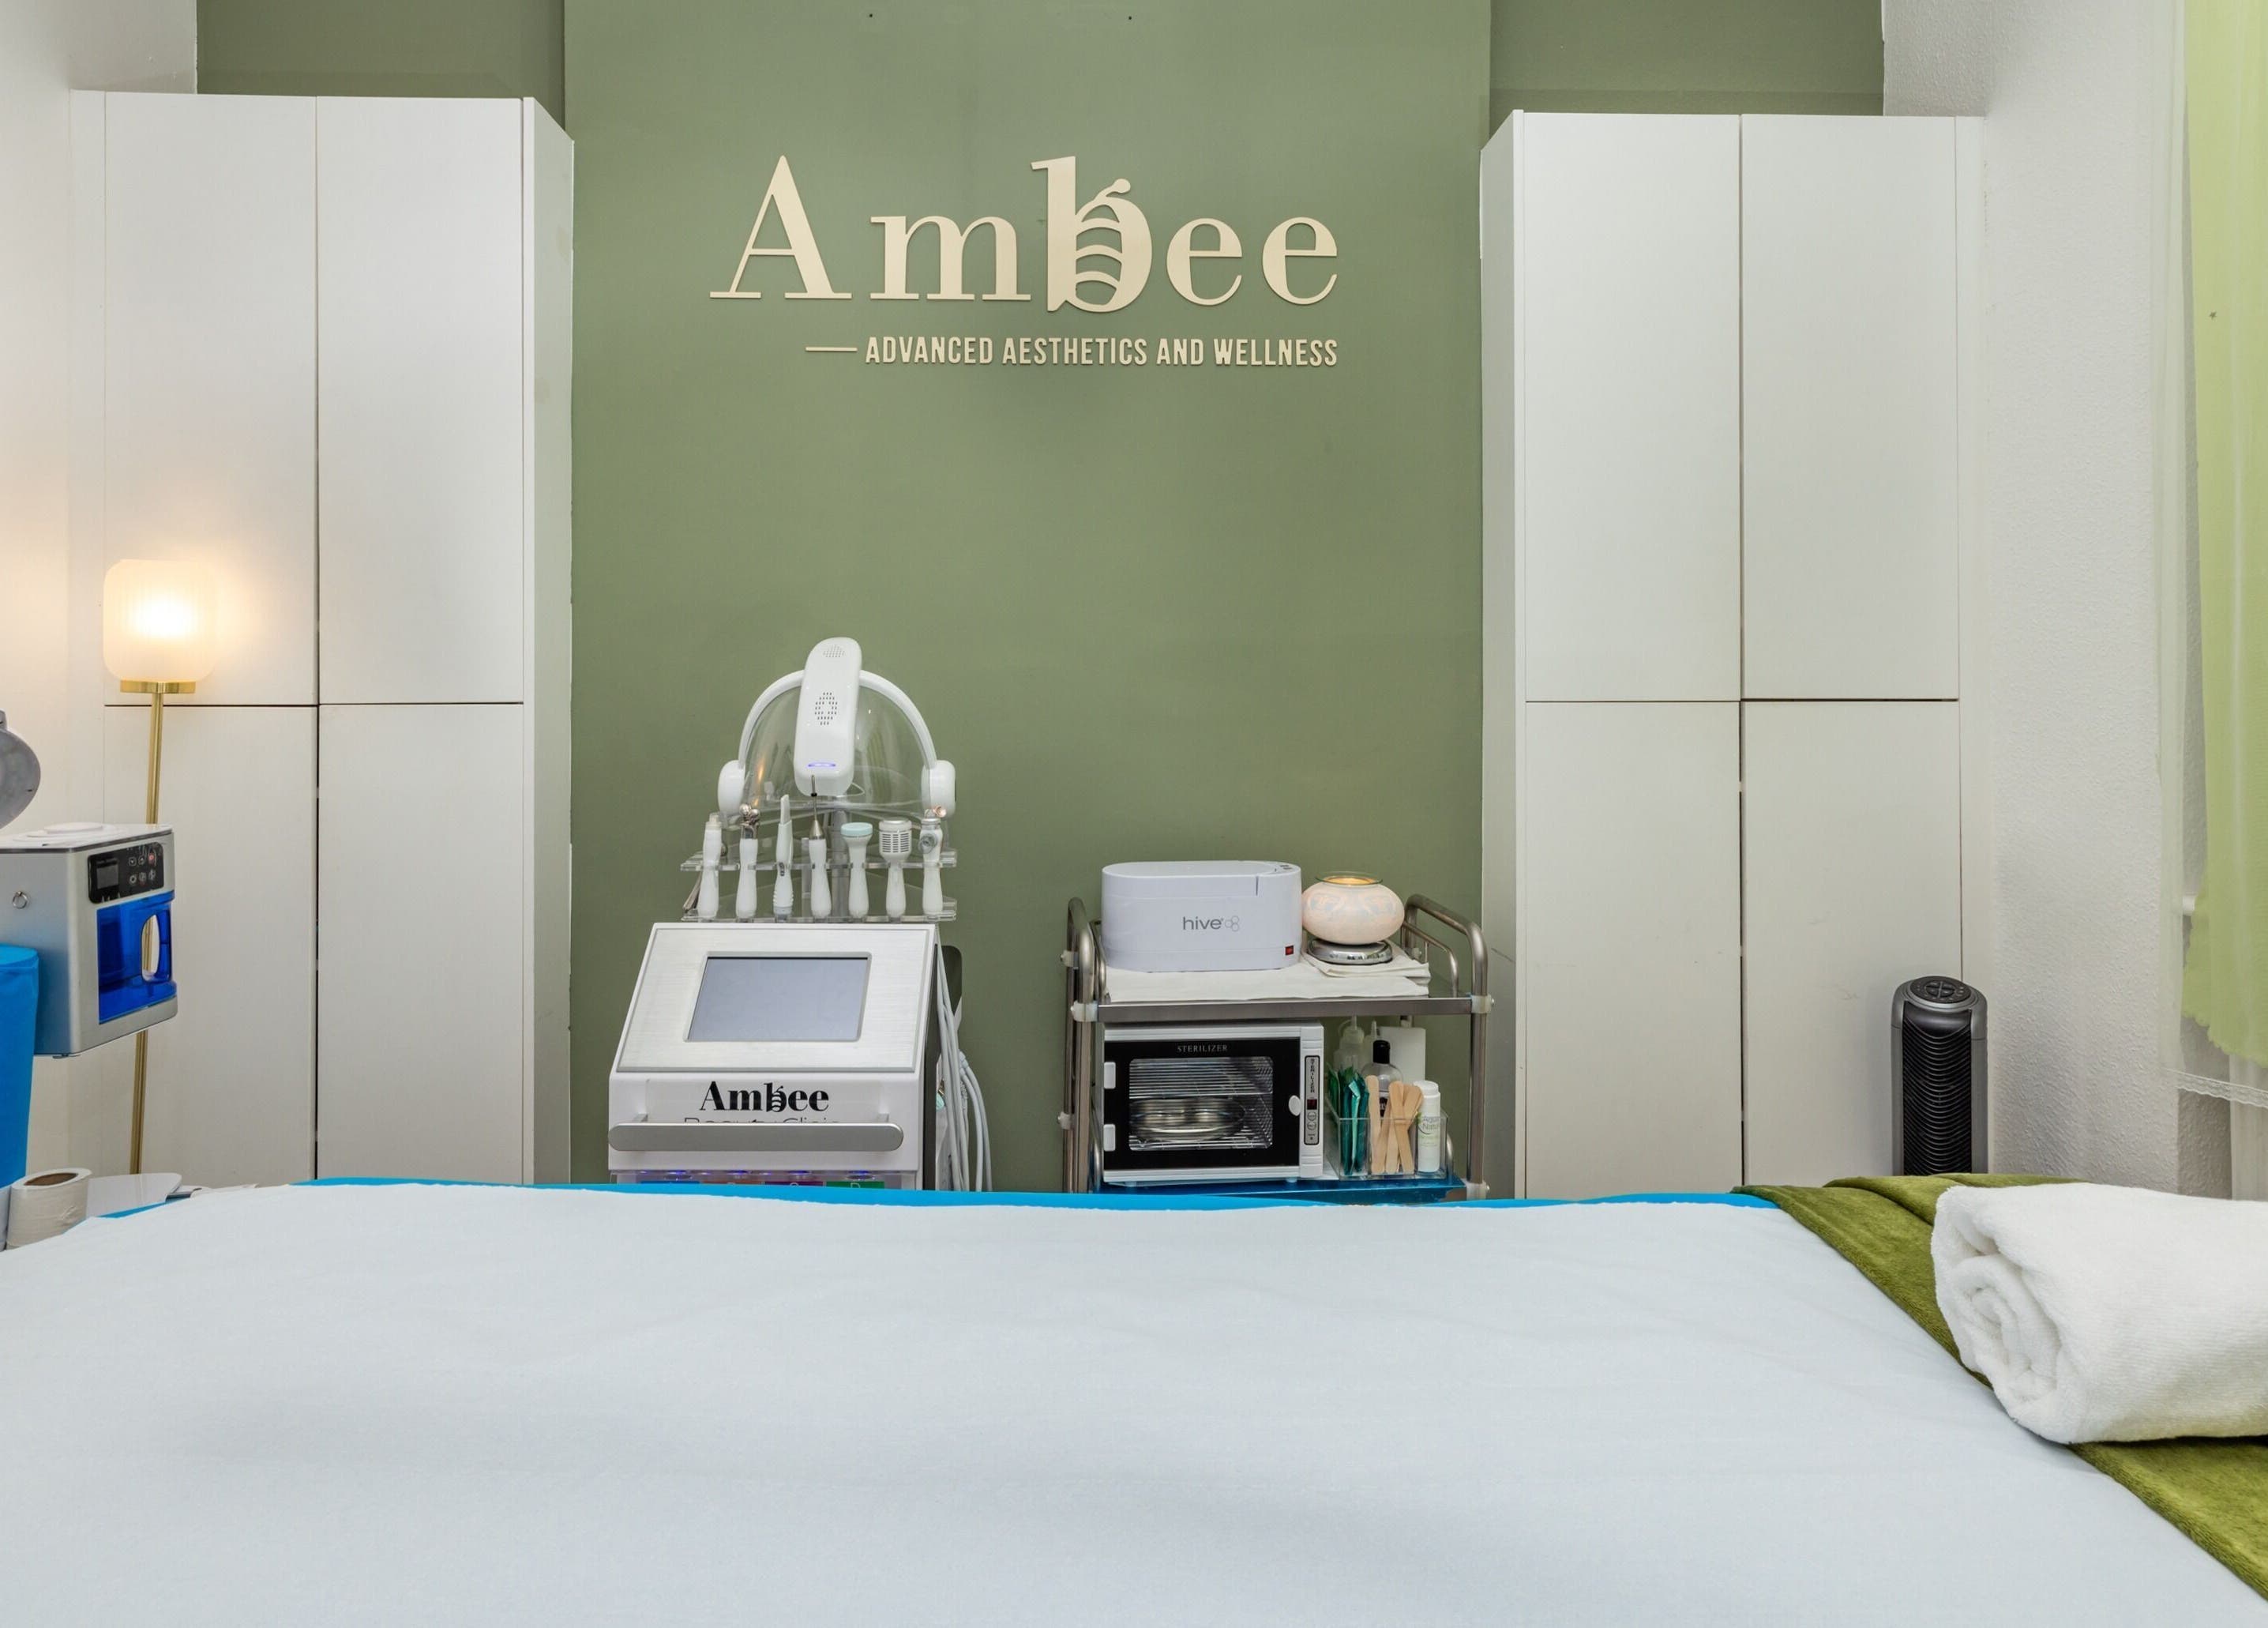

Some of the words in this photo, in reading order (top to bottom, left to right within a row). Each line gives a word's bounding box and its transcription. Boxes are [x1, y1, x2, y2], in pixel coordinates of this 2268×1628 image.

[709, 155, 1339, 313] Ambee
[866, 337, 993, 364] ADVANCED
[1002, 337, 1147, 365] AESTHETICS
[1156, 338, 1204, 366] AND
[1213, 339, 1338, 367] WELLNESS
[1177, 1044, 1228, 1053] STERILIZER
[699, 1081, 829, 1112] Ambee
